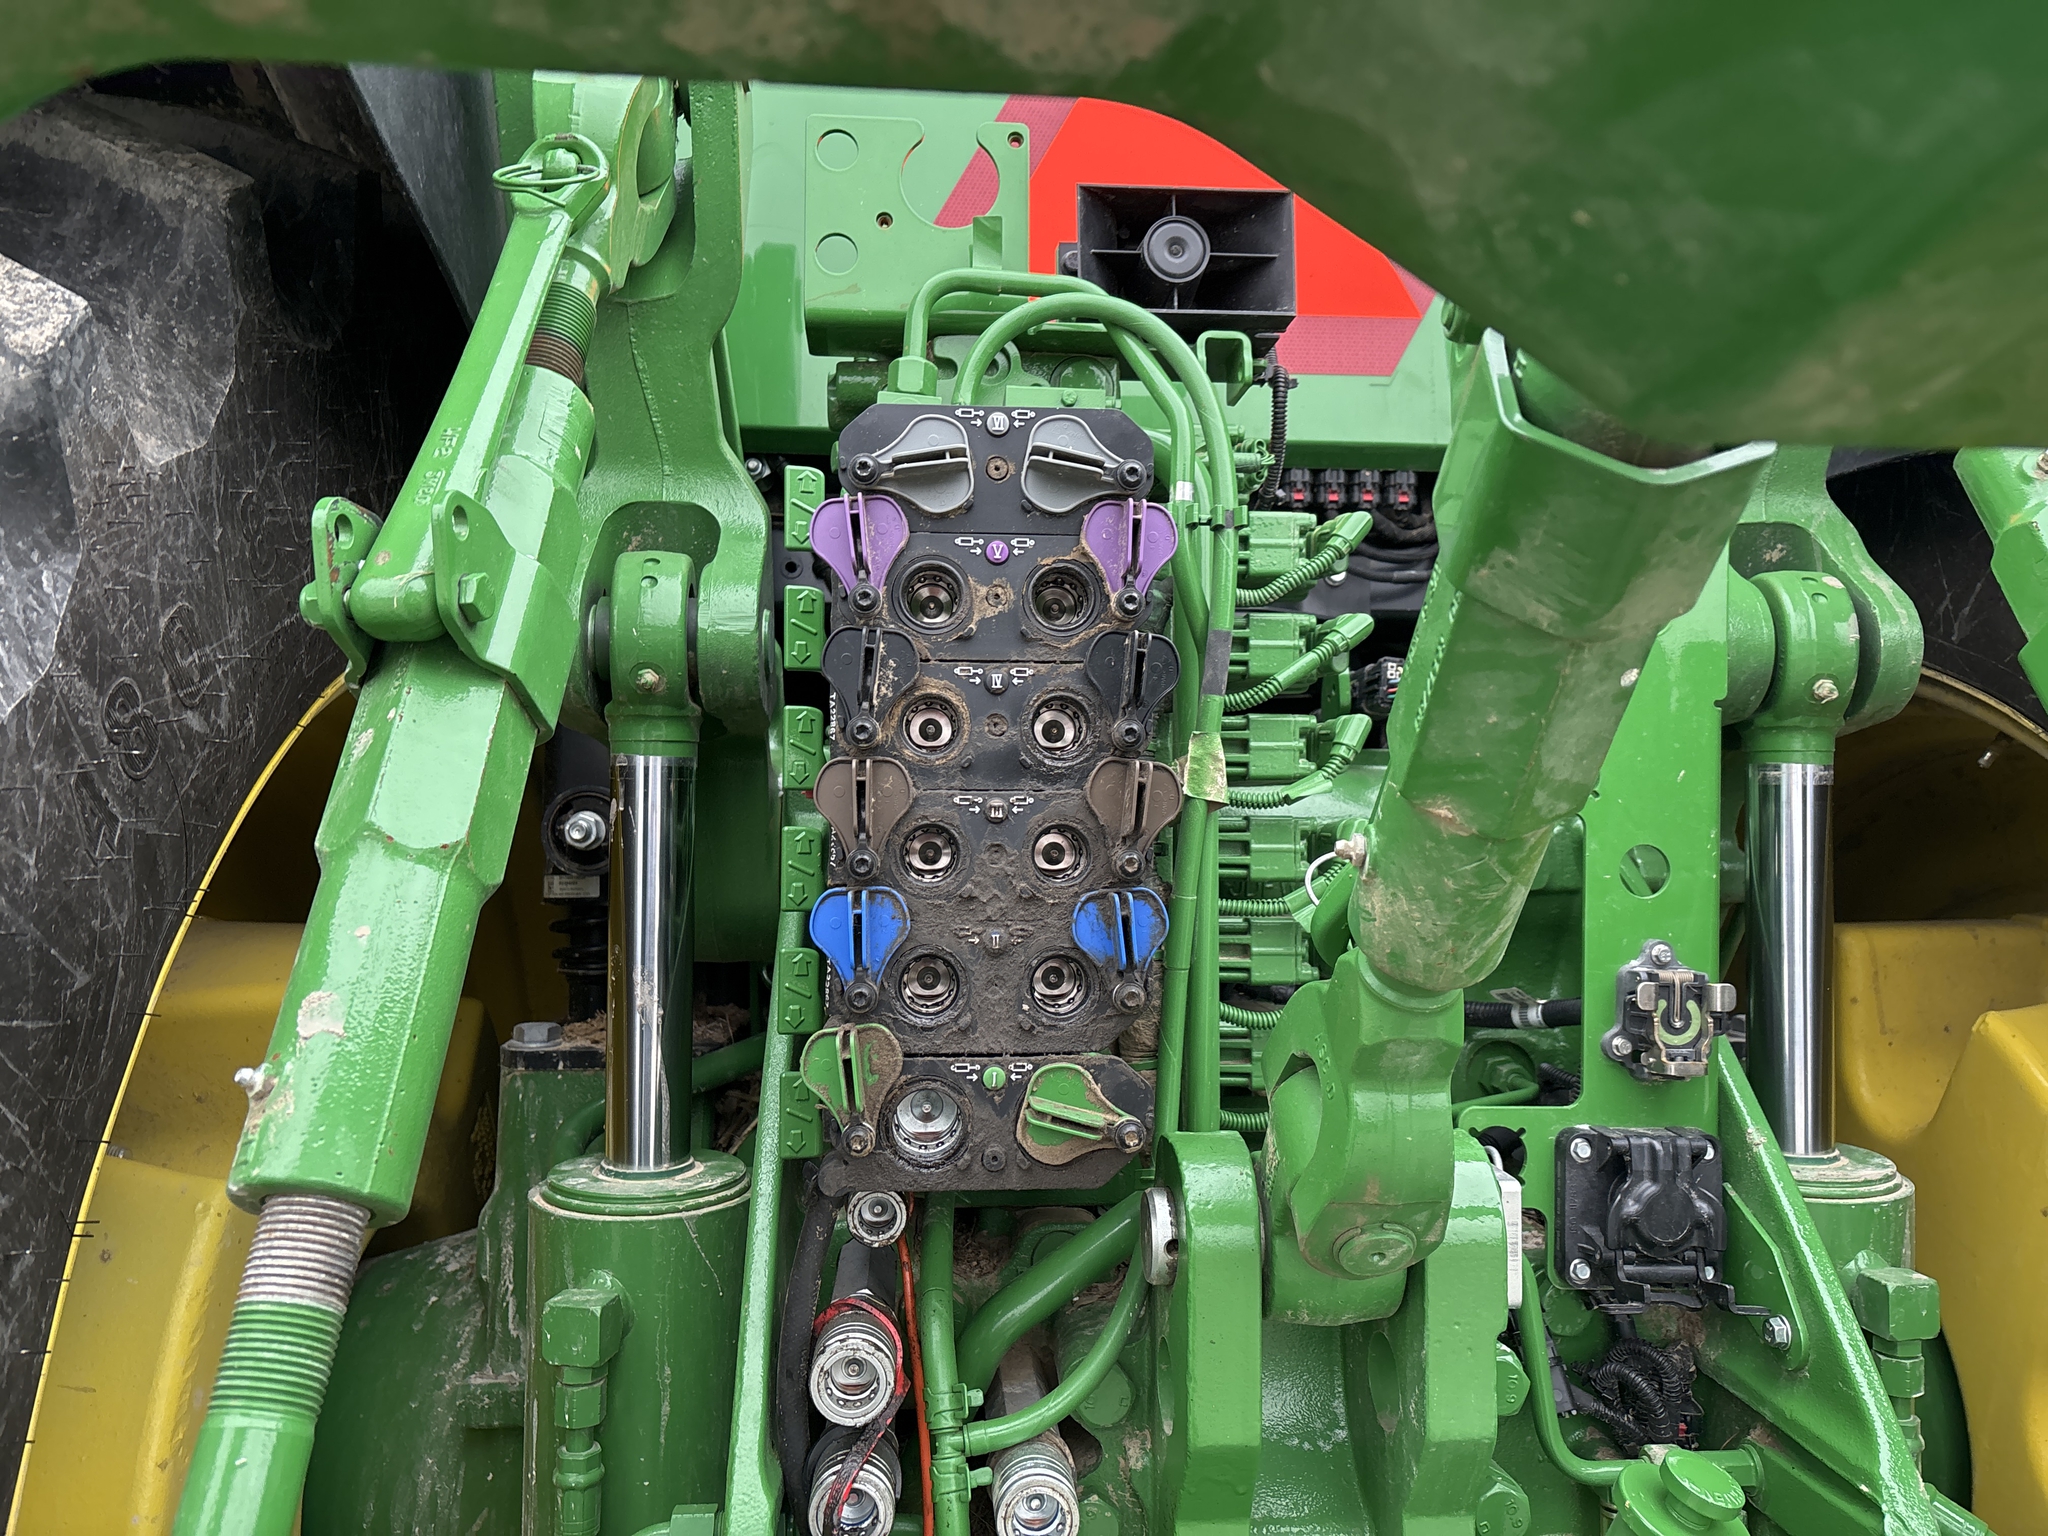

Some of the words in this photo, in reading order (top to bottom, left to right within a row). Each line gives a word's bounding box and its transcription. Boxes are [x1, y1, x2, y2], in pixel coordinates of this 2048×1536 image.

[991, 415, 1005, 430] VI
[992, 544, 1004, 559] V
[991, 673, 1003, 688] IV
